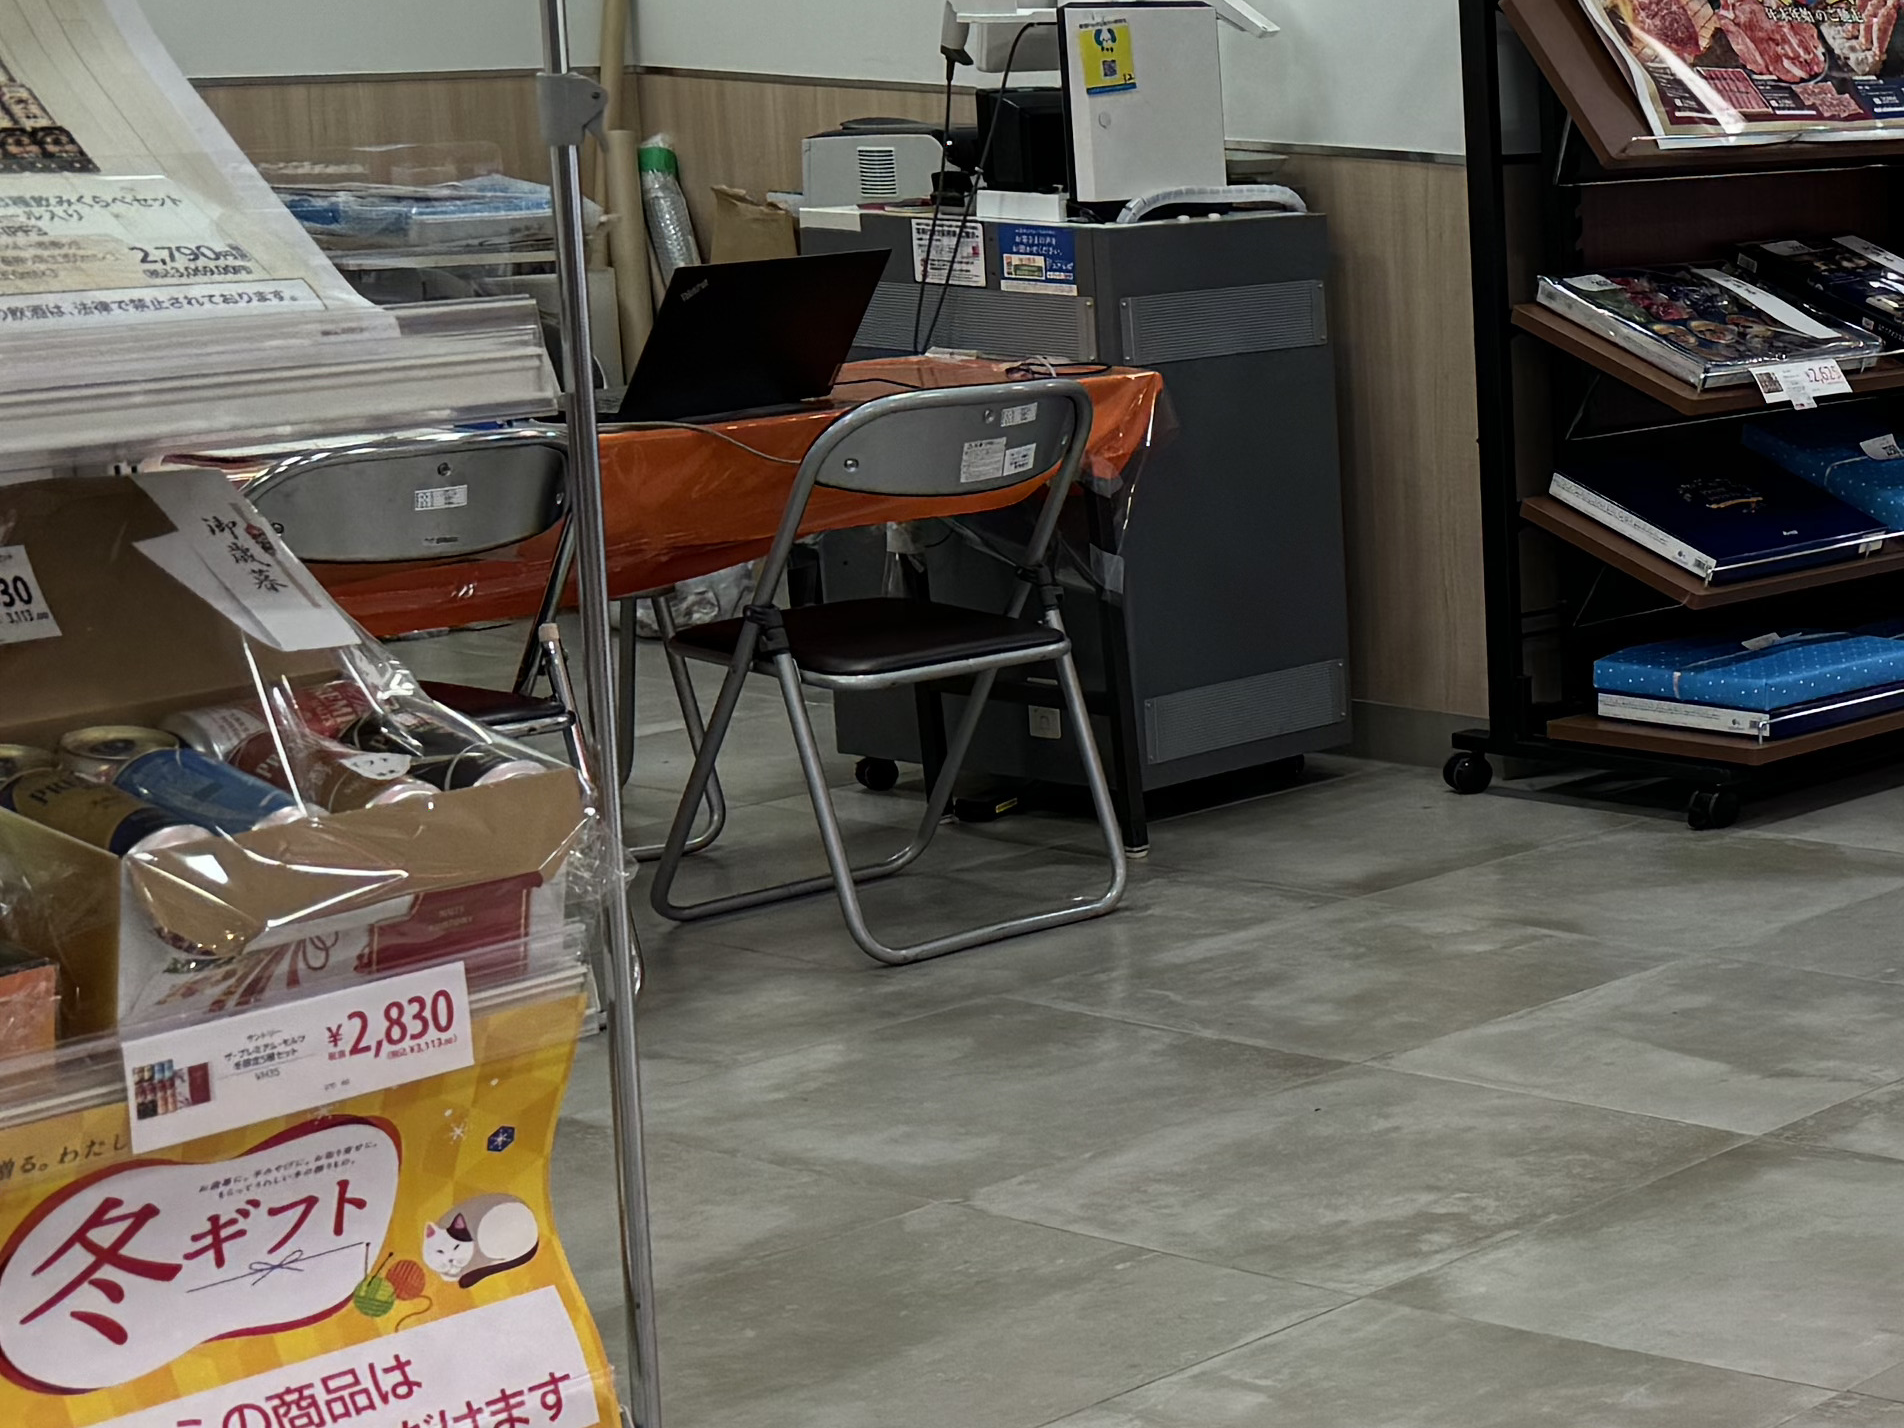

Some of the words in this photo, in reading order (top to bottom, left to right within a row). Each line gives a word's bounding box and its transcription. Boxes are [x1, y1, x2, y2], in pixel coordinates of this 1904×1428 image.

[200, 515, 288, 593] 御歳暮
[326, 989, 455, 1059] ¥2,830
[19, 1178, 368, 1346] 冬ギフト
